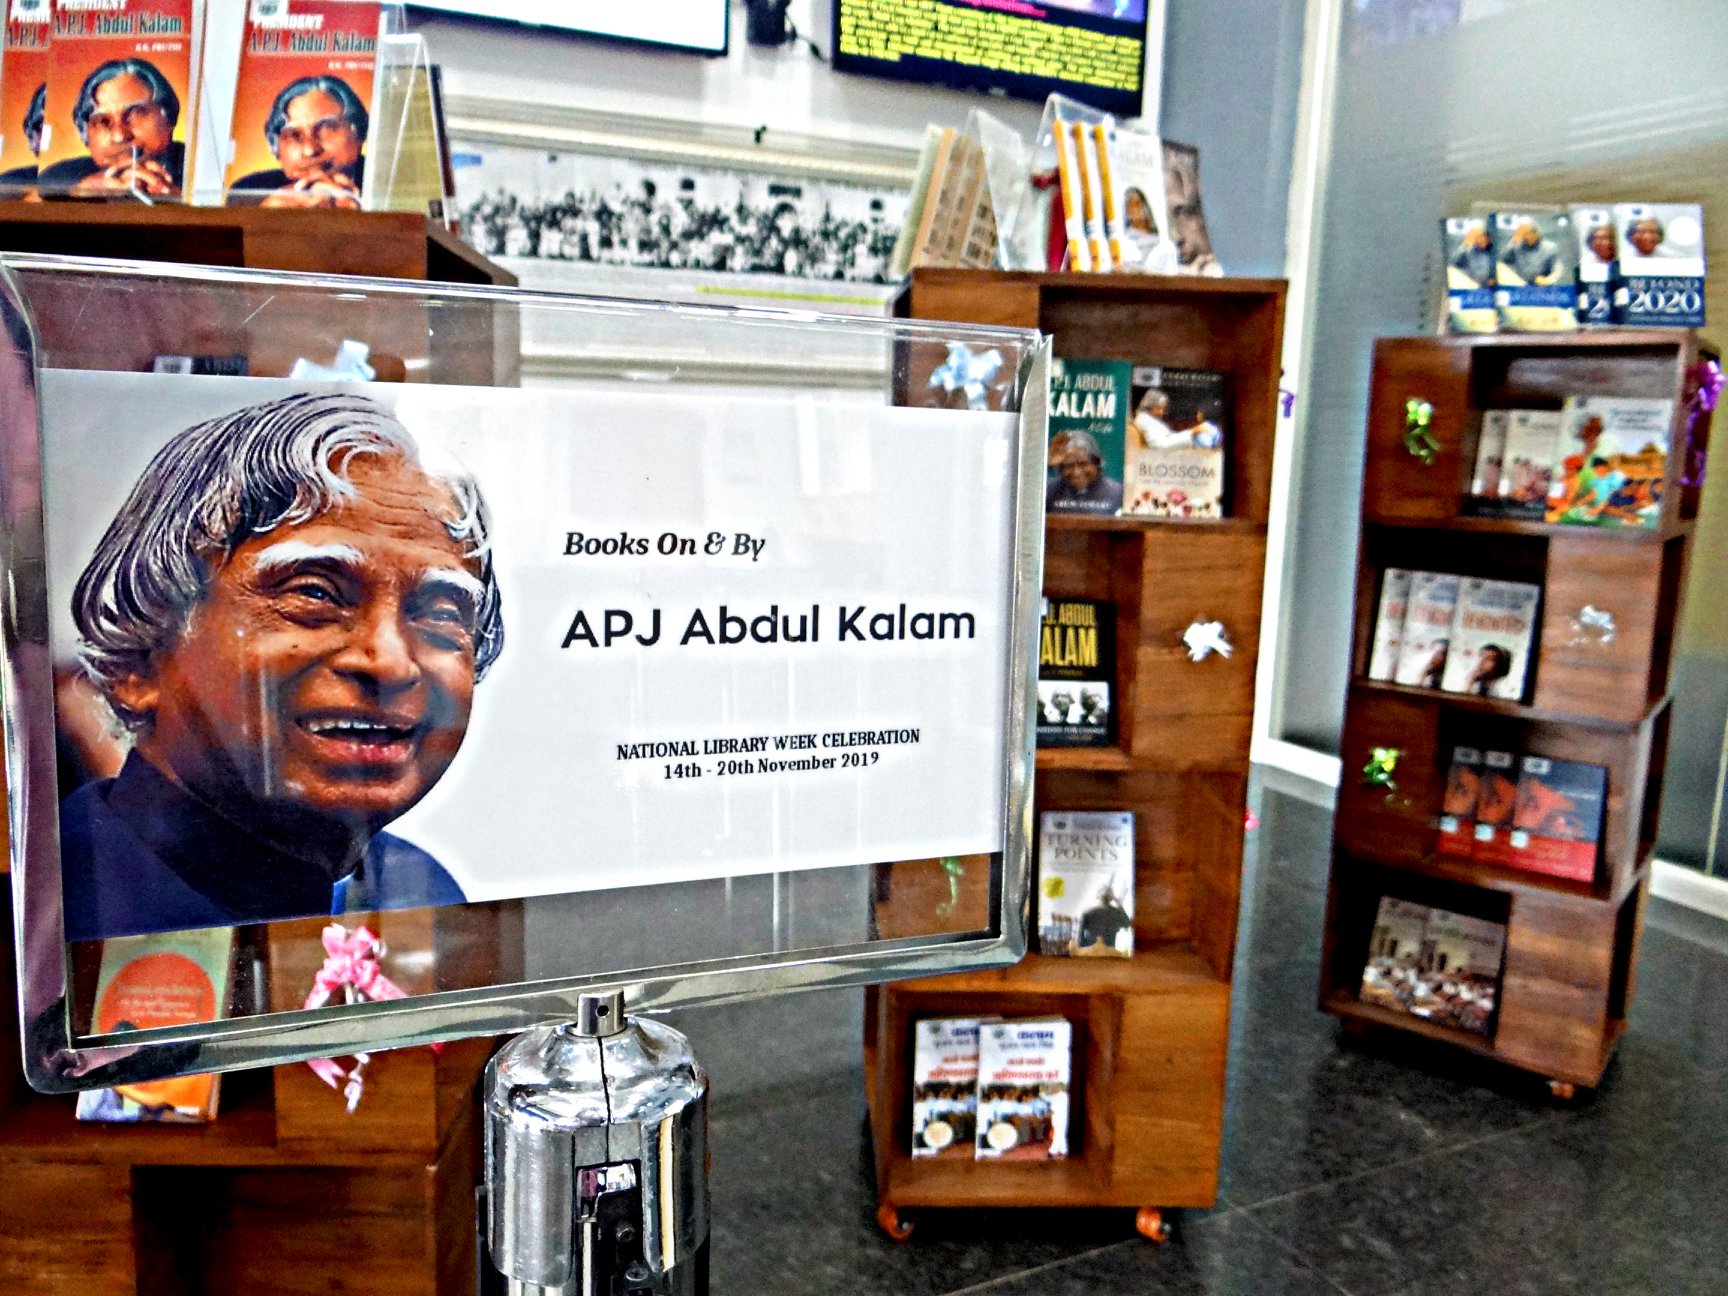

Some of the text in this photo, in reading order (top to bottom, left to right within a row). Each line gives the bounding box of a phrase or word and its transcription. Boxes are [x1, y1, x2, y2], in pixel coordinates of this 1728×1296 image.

[97, 12, 134, 34] Abdul
[139, 11, 182, 33] Kalam
[289, 31, 328, 52] Abdul
[333, 30, 375, 52] Kalam
[1629, 288, 1701, 313] 2020
[1138, 463, 1215, 479] BLOSSOM
[563, 531, 765, 562] Books On & By
[561, 603, 976, 649] APJ Abdul Kalam
[1041, 626, 1098, 668] ALAM
[616, 729, 920, 761] NATIONAL LIBRARY WEEK CELEBRATION
[664, 763, 702, 780] 14th
[717, 760, 754, 776] 20th
[757, 754, 837, 773] November
[841, 751, 880, 767] 2019
